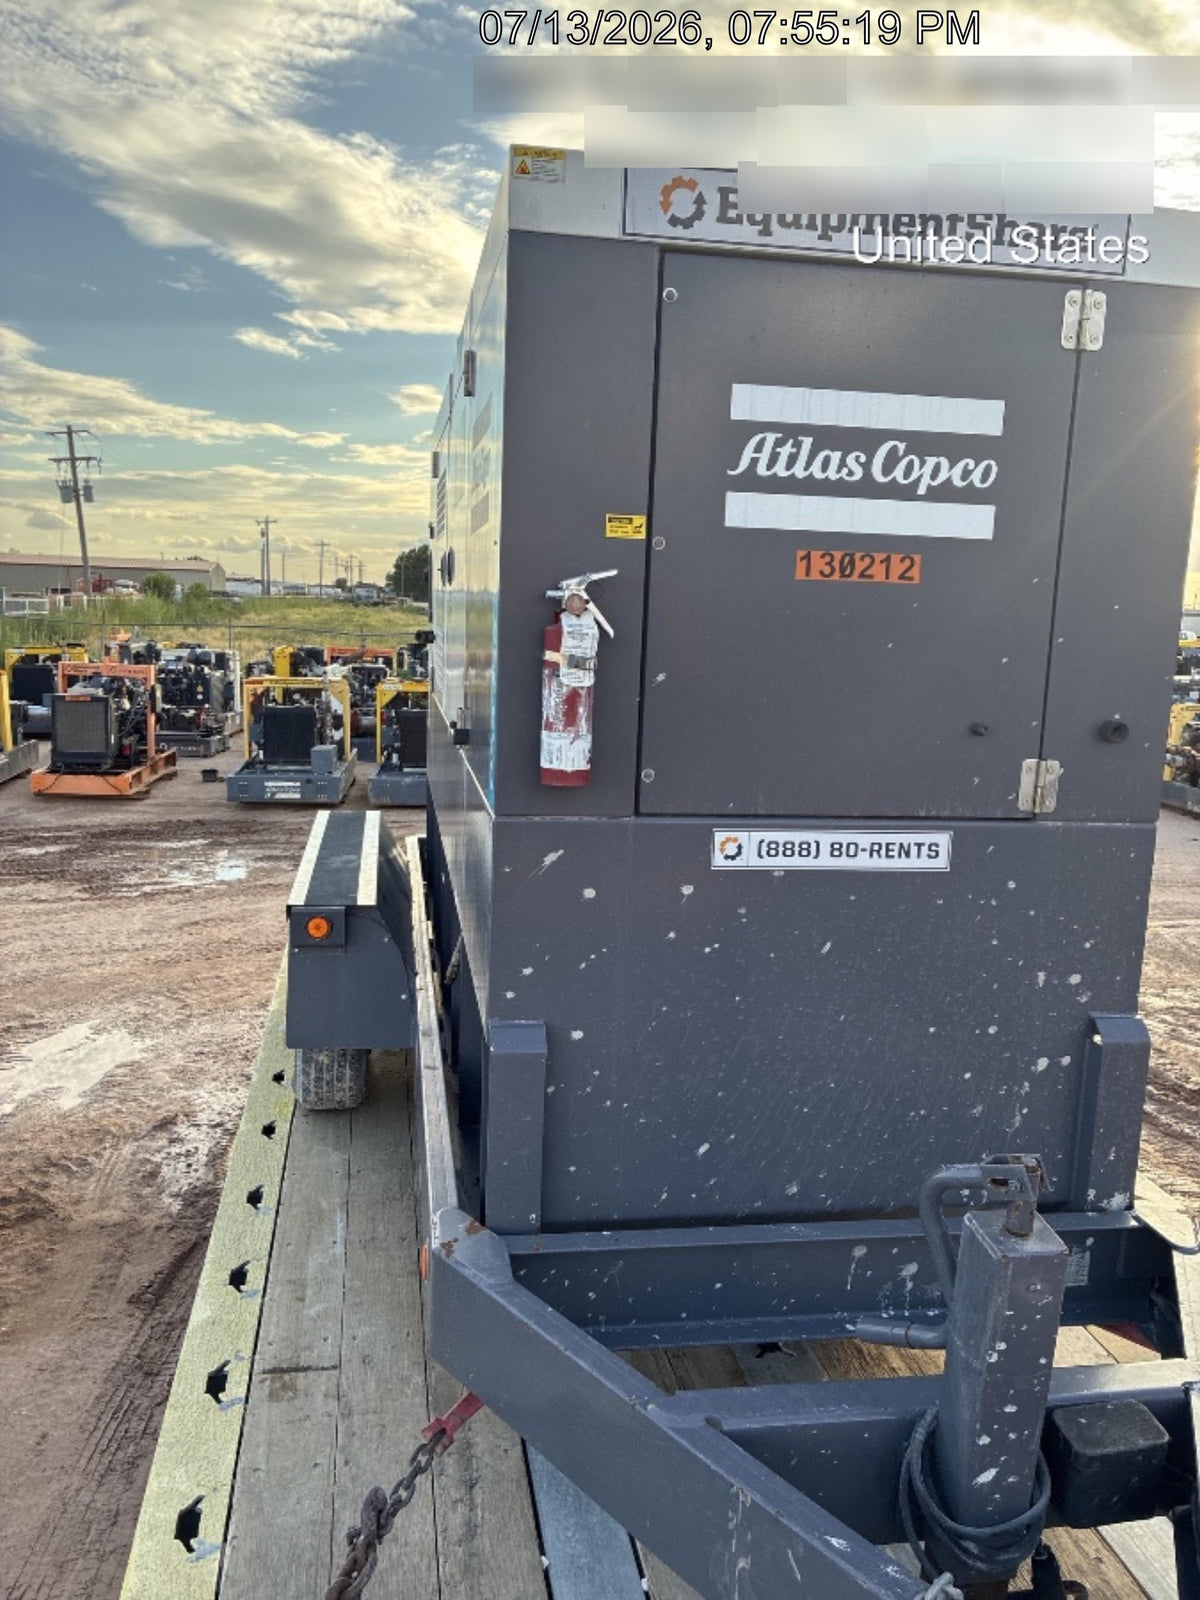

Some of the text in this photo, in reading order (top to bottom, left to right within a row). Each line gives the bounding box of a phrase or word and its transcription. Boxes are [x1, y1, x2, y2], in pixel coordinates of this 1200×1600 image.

[726, 432, 998, 495] Atlas Copco
[799, 550, 916, 581] 130212
[757, 839, 940, 860] (888) 80-RENTS
